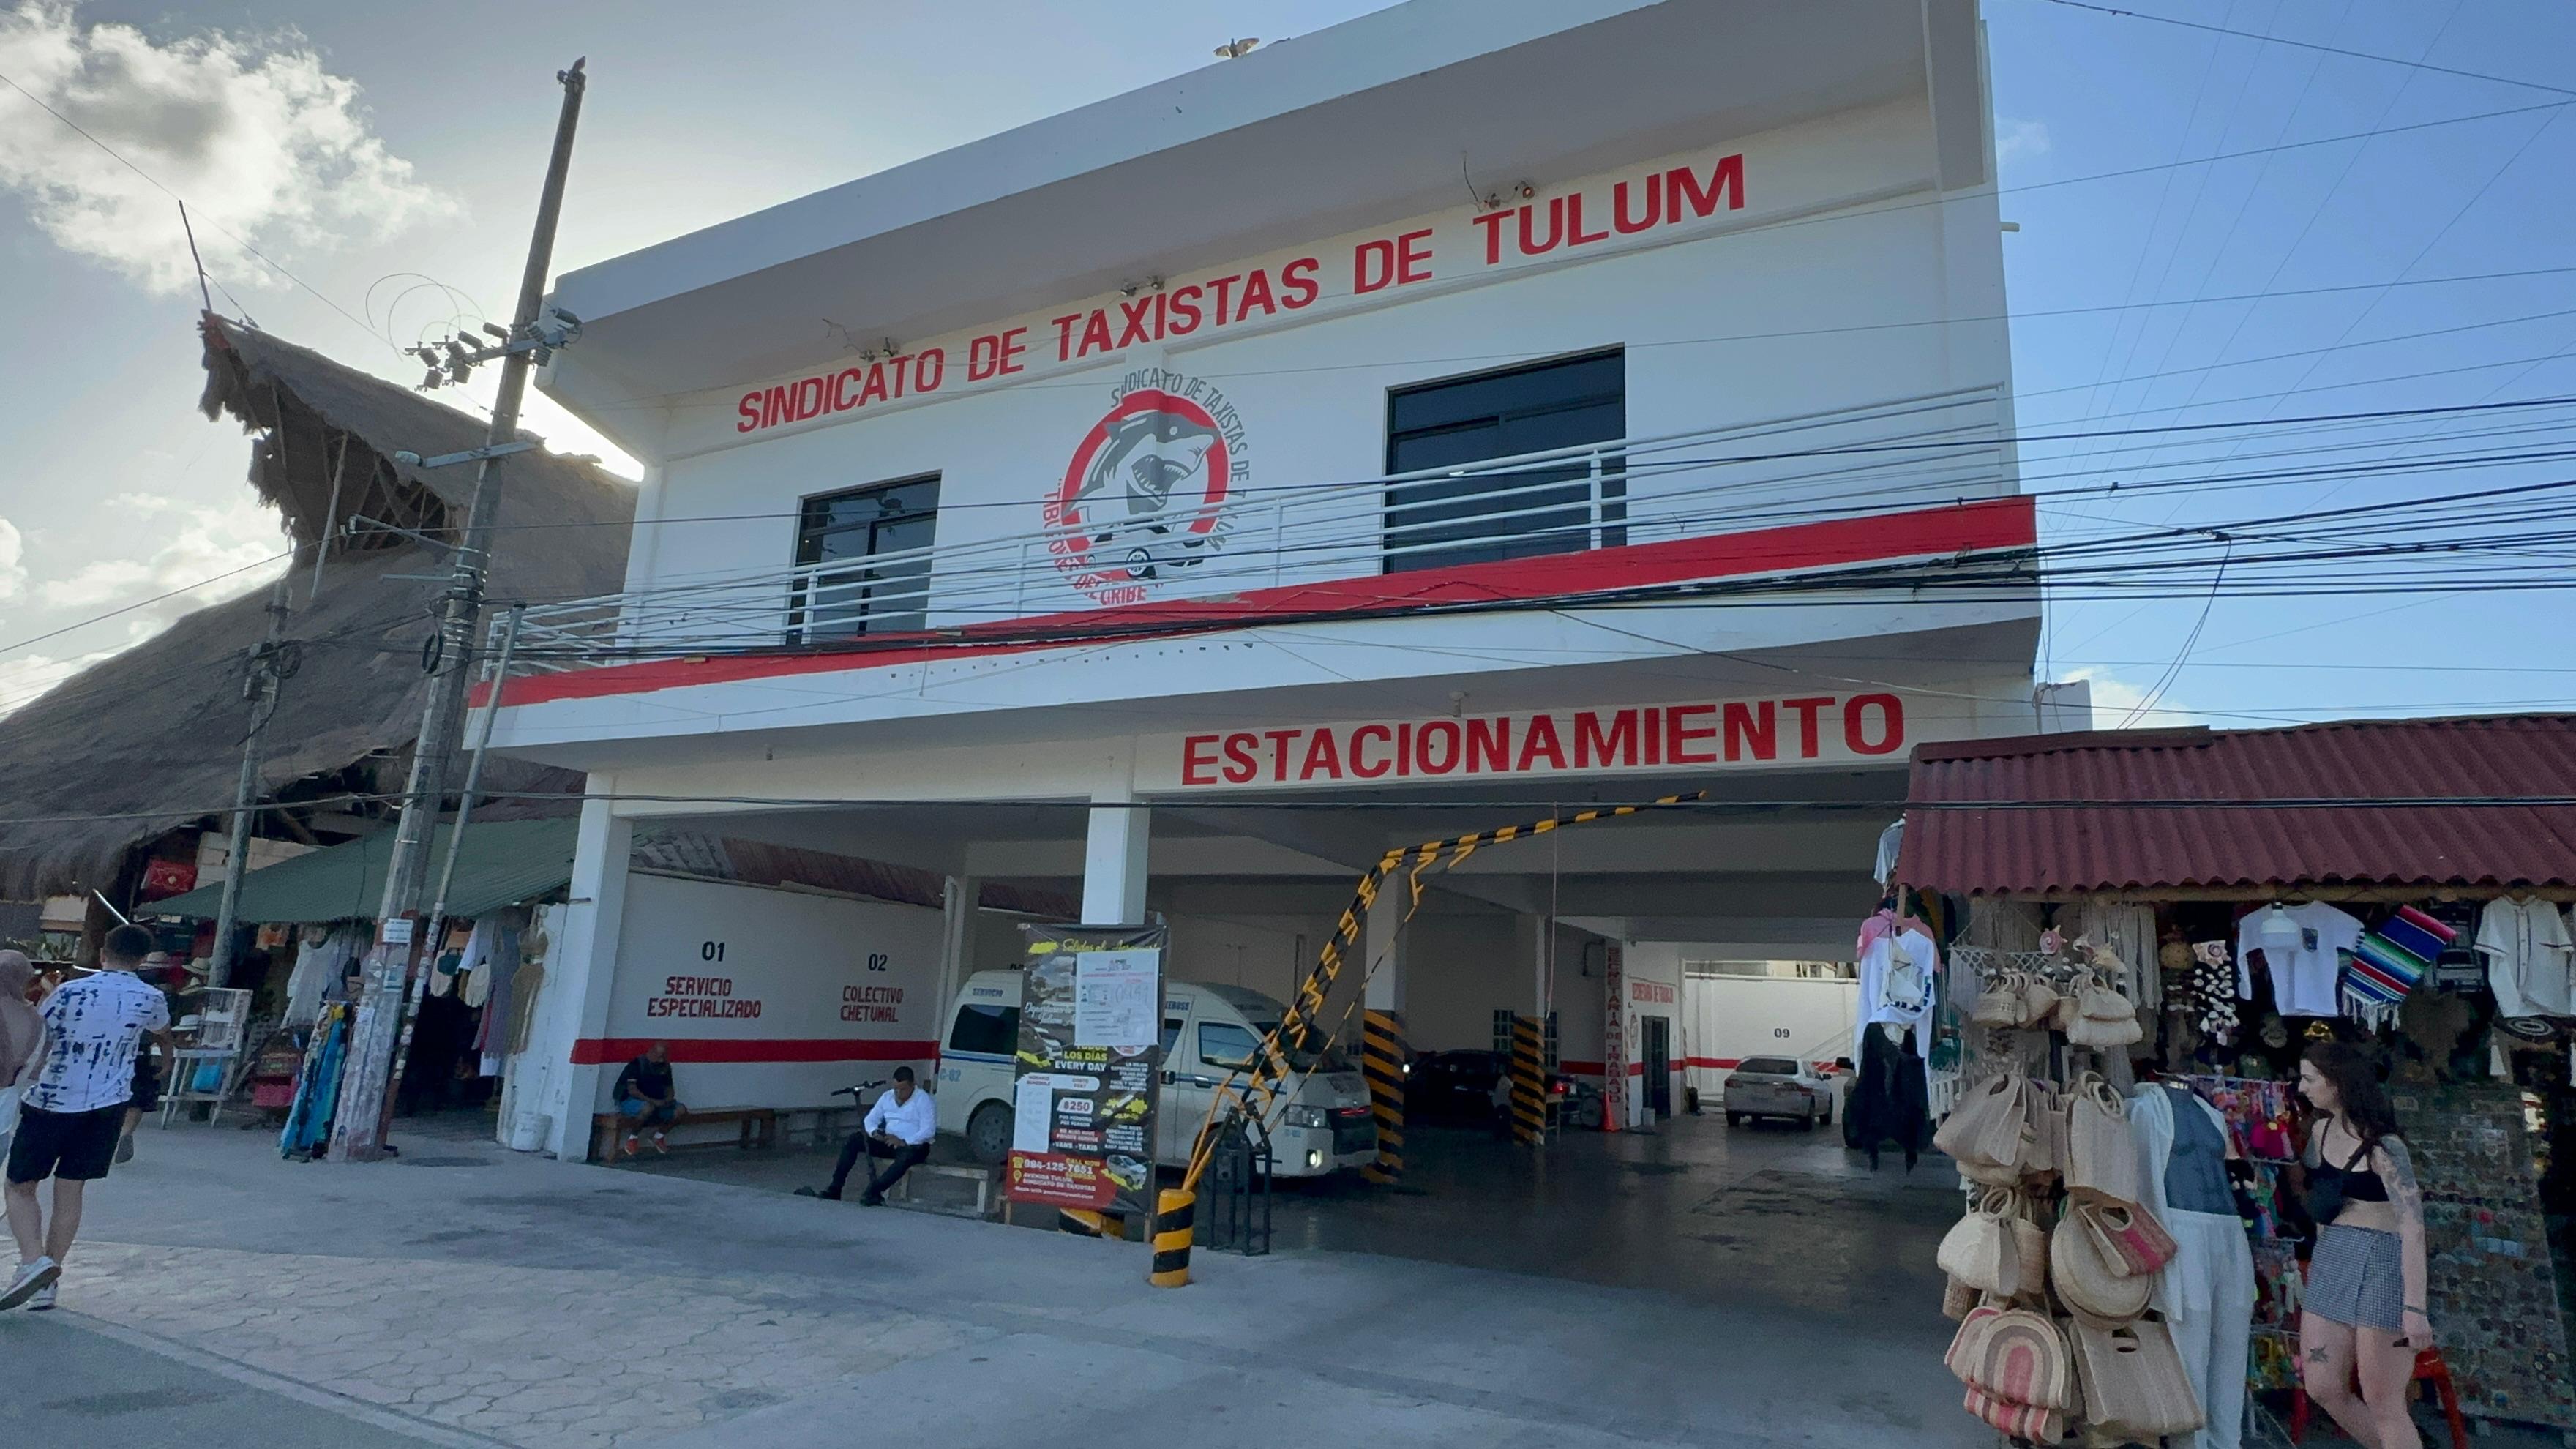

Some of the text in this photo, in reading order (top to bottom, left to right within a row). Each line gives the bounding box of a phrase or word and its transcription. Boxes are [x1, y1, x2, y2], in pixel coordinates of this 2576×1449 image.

[737, 153, 1745, 433] SINDICATO DE TAXISTAS DE TULUM
[1186, 376, 1208, 401] DE
[1202, 386, 1248, 457] TAXISTAS
[1230, 460, 1250, 483] DE
[1180, 692, 1904, 787] ESTACIONAMIENTO
[701, 940, 725, 962] 01
[868, 953, 888, 972] 02
[664, 976, 733, 997] SERVICIO
[842, 984, 904, 1005] COLECTIVO
[647, 997, 762, 1019] ESPECIALIZADO
[839, 1005, 899, 1023] CHETUMAL
[1773, 1027, 1791, 1038] 09
[1054, 1060, 1107, 1071] EVERY DAY
[1063, 1050, 1082, 1060] LOS
[1085, 1049, 1108, 1061] DÍAS
[1063, 1101, 1091, 1112] $250
